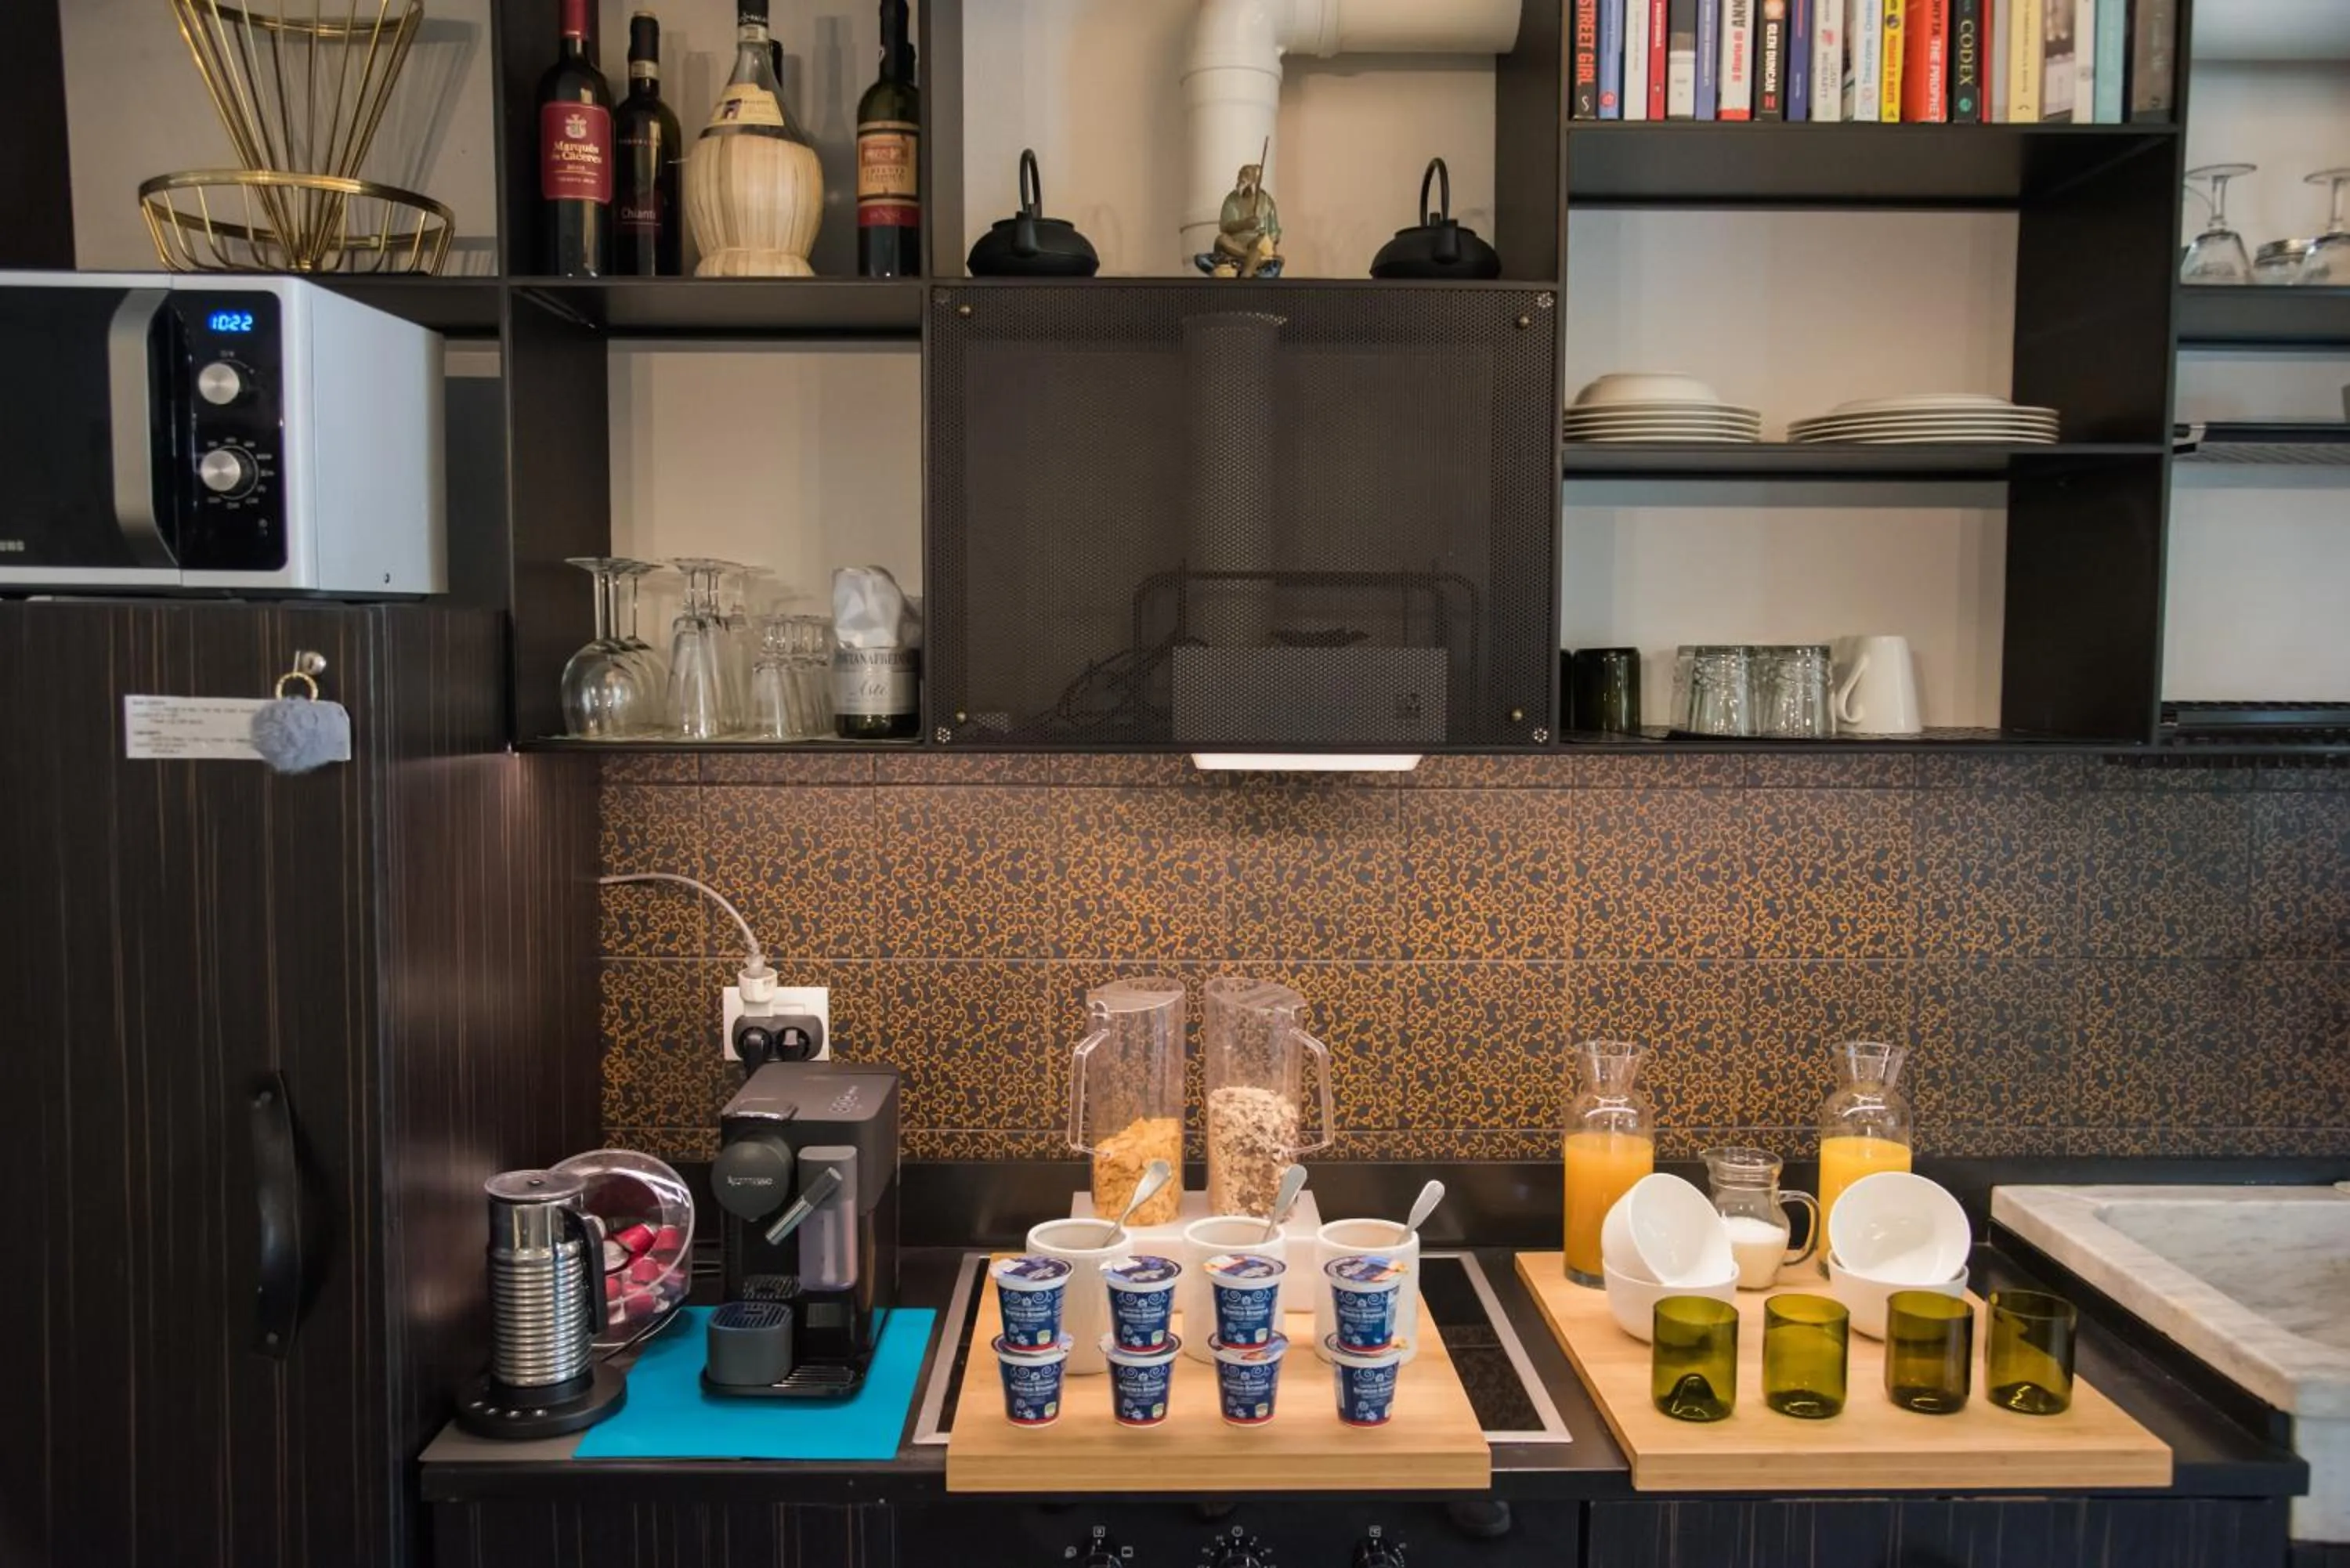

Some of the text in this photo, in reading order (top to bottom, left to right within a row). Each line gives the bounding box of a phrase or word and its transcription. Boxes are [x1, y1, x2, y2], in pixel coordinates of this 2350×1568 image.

[1577, 0, 1597, 86] STREET GIRL
[1766, 23, 1778, 49] GLEN
[1930, 38, 1941, 62] THE
[1959, 19, 1975, 85] CODEX
[1764, 50, 1777, 92] DUNCAN
